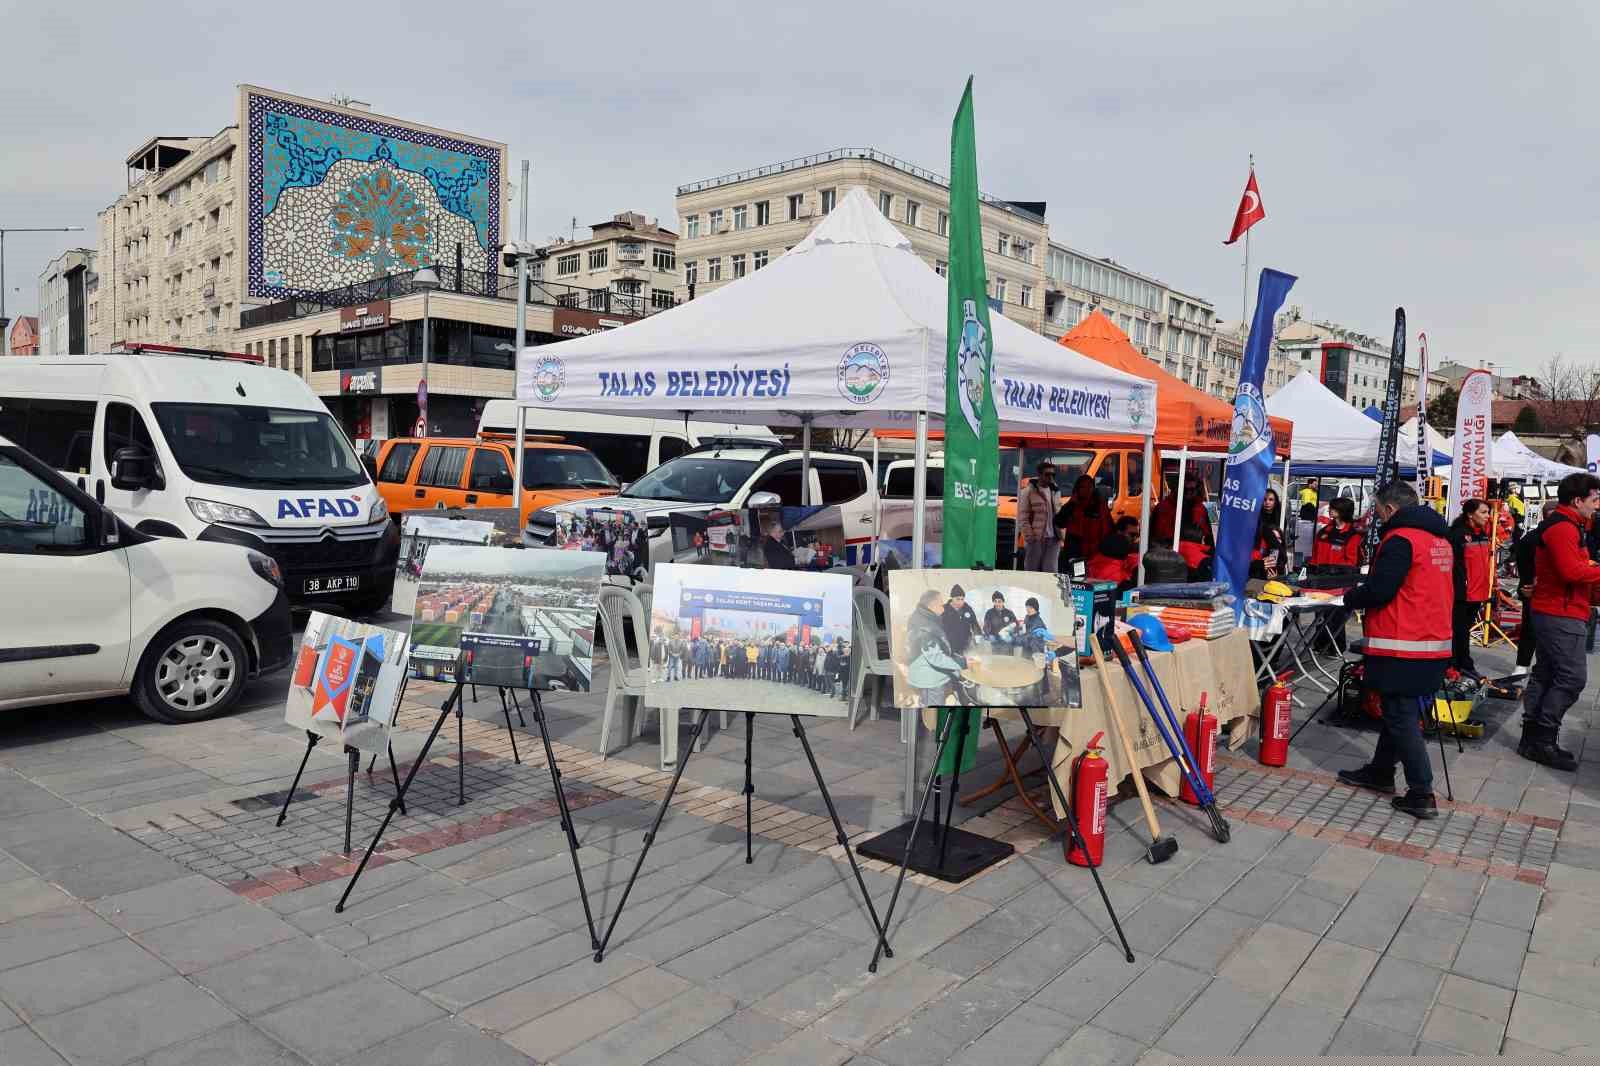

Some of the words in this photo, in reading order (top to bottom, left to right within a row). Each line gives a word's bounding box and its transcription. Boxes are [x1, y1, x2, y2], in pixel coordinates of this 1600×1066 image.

[599, 371, 656, 397] TALAS
[666, 363, 790, 397] BELEDİYESİ
[1003, 378, 1044, 410] TALAS
[1050, 386, 1111, 419] BELEDİYESİ
[1463, 417, 1473, 438] VE
[278, 498, 360, 519] AFAD
[308, 580, 320, 591] 38
[326, 579, 343, 590] AKP
[346, 577, 357, 588] 110
